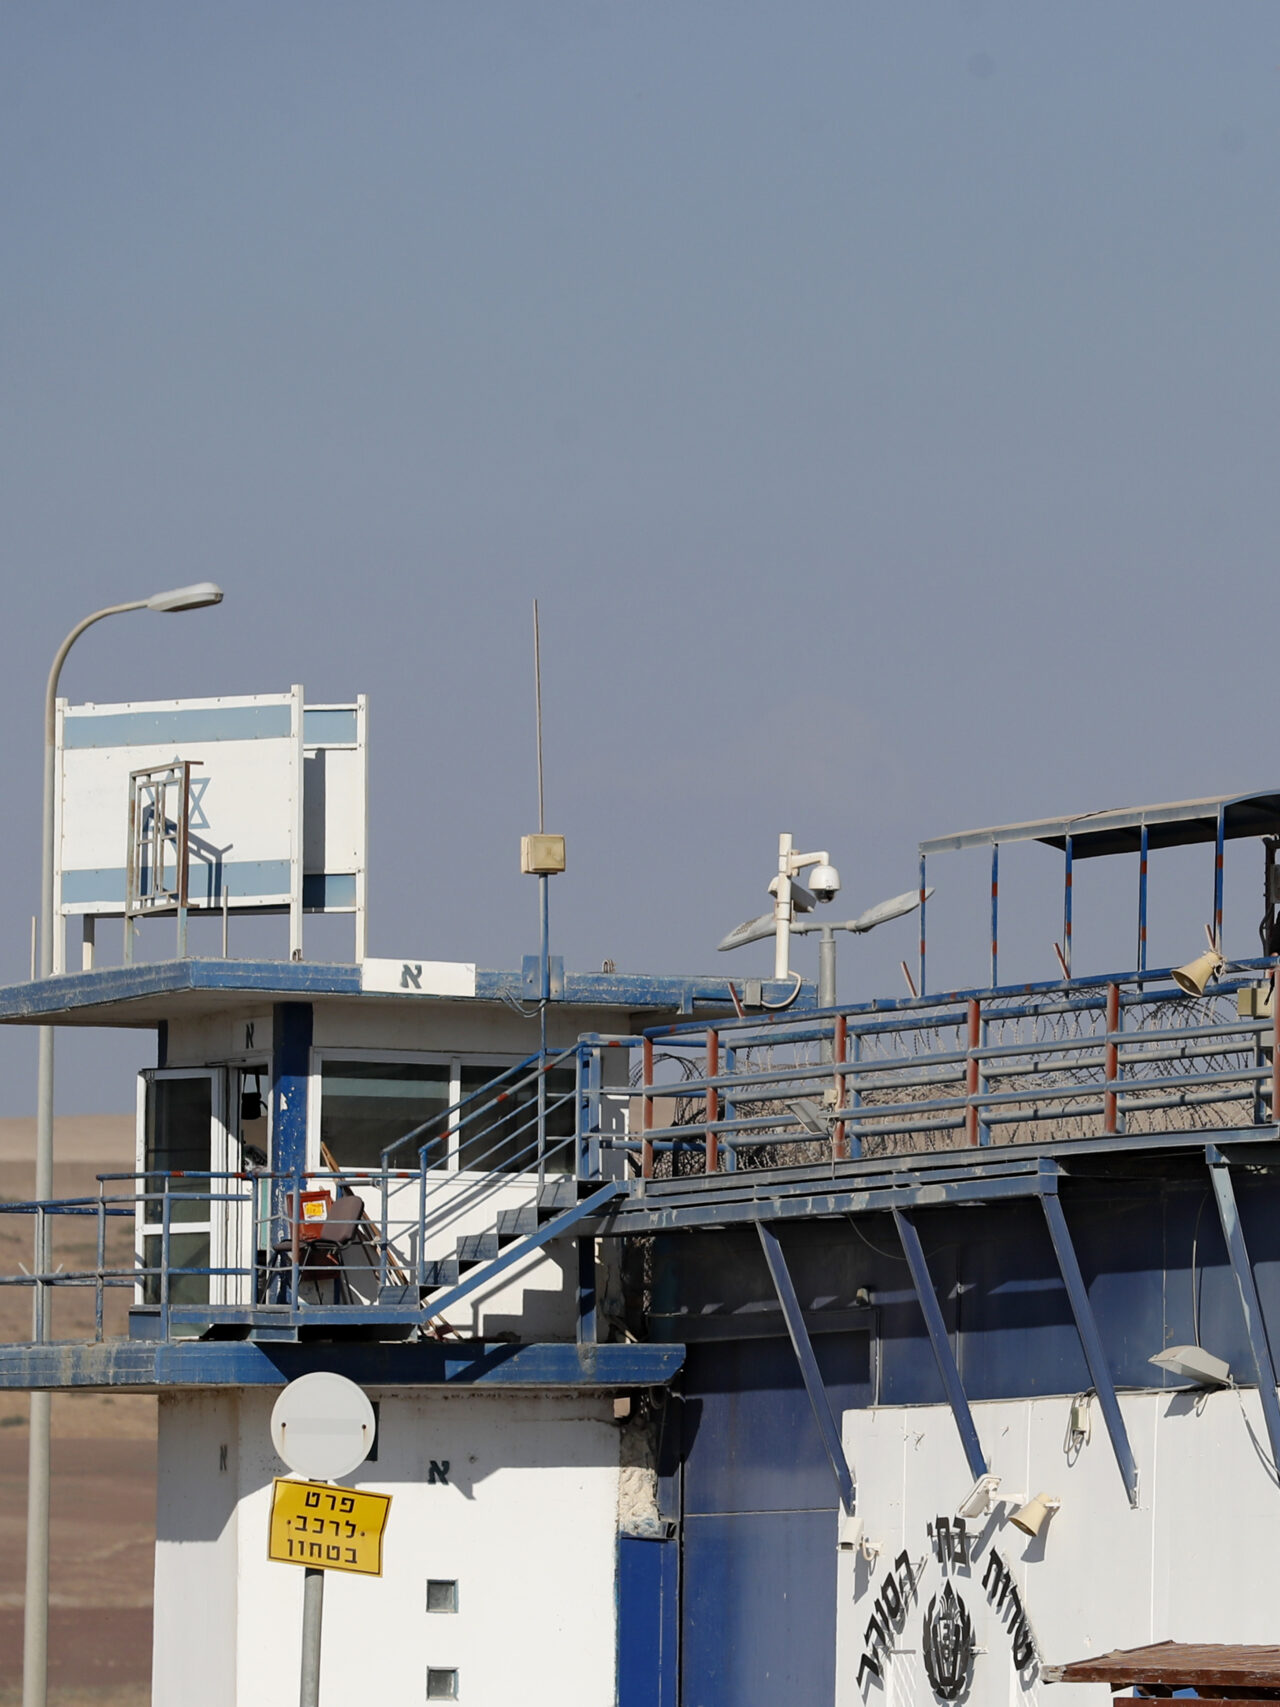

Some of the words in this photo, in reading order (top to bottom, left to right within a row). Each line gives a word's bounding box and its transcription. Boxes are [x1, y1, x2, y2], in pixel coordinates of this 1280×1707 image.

[400, 964, 422, 989] א
[245, 1021, 255, 1049] א
[427, 1460, 450, 1485] א
[305, 1491, 355, 1513] פרט
[295, 1515, 357, 1538] לרכב
[926, 1514, 967, 1564] בתי
[287, 1538, 358, 1564] בטחון
[856, 1549, 916, 1689] הסוהר
